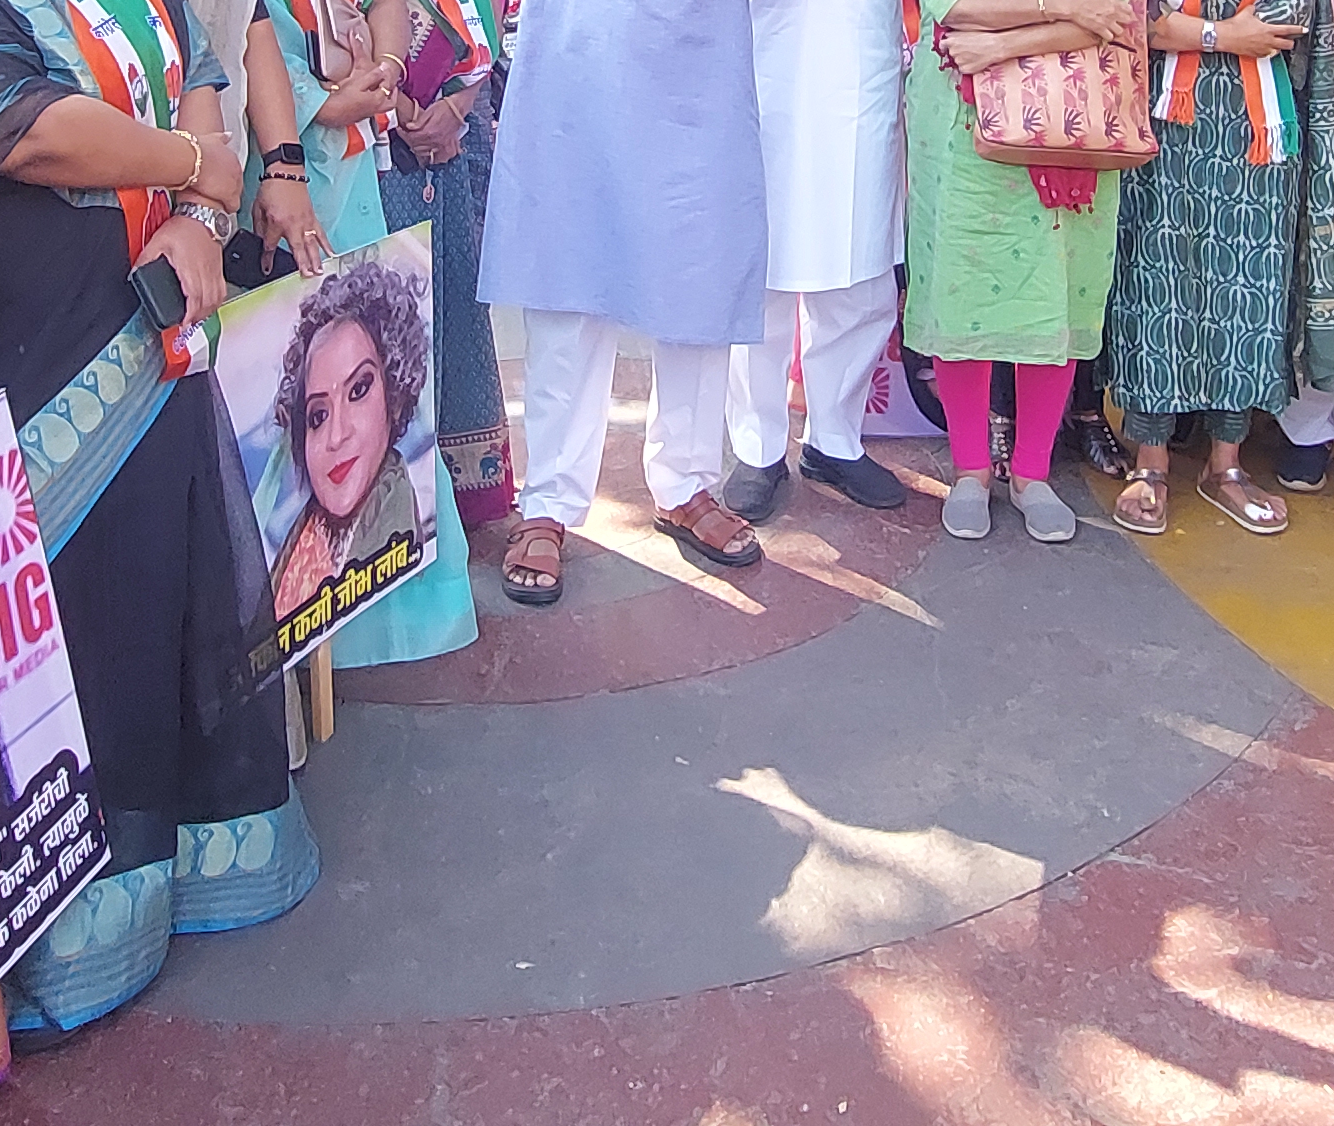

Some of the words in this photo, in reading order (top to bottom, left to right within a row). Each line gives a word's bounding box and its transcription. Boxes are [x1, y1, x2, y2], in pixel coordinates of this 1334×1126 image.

[292, 585, 333, 643] कमी
[334, 568, 374, 612] जीभ
[11, 767, 71, 842] सर्जरीची
[39, 792, 90, 857] त्यामुळे
[8, 866, 60, 931] कळेना
[57, 830, 99, 882] तिला.
